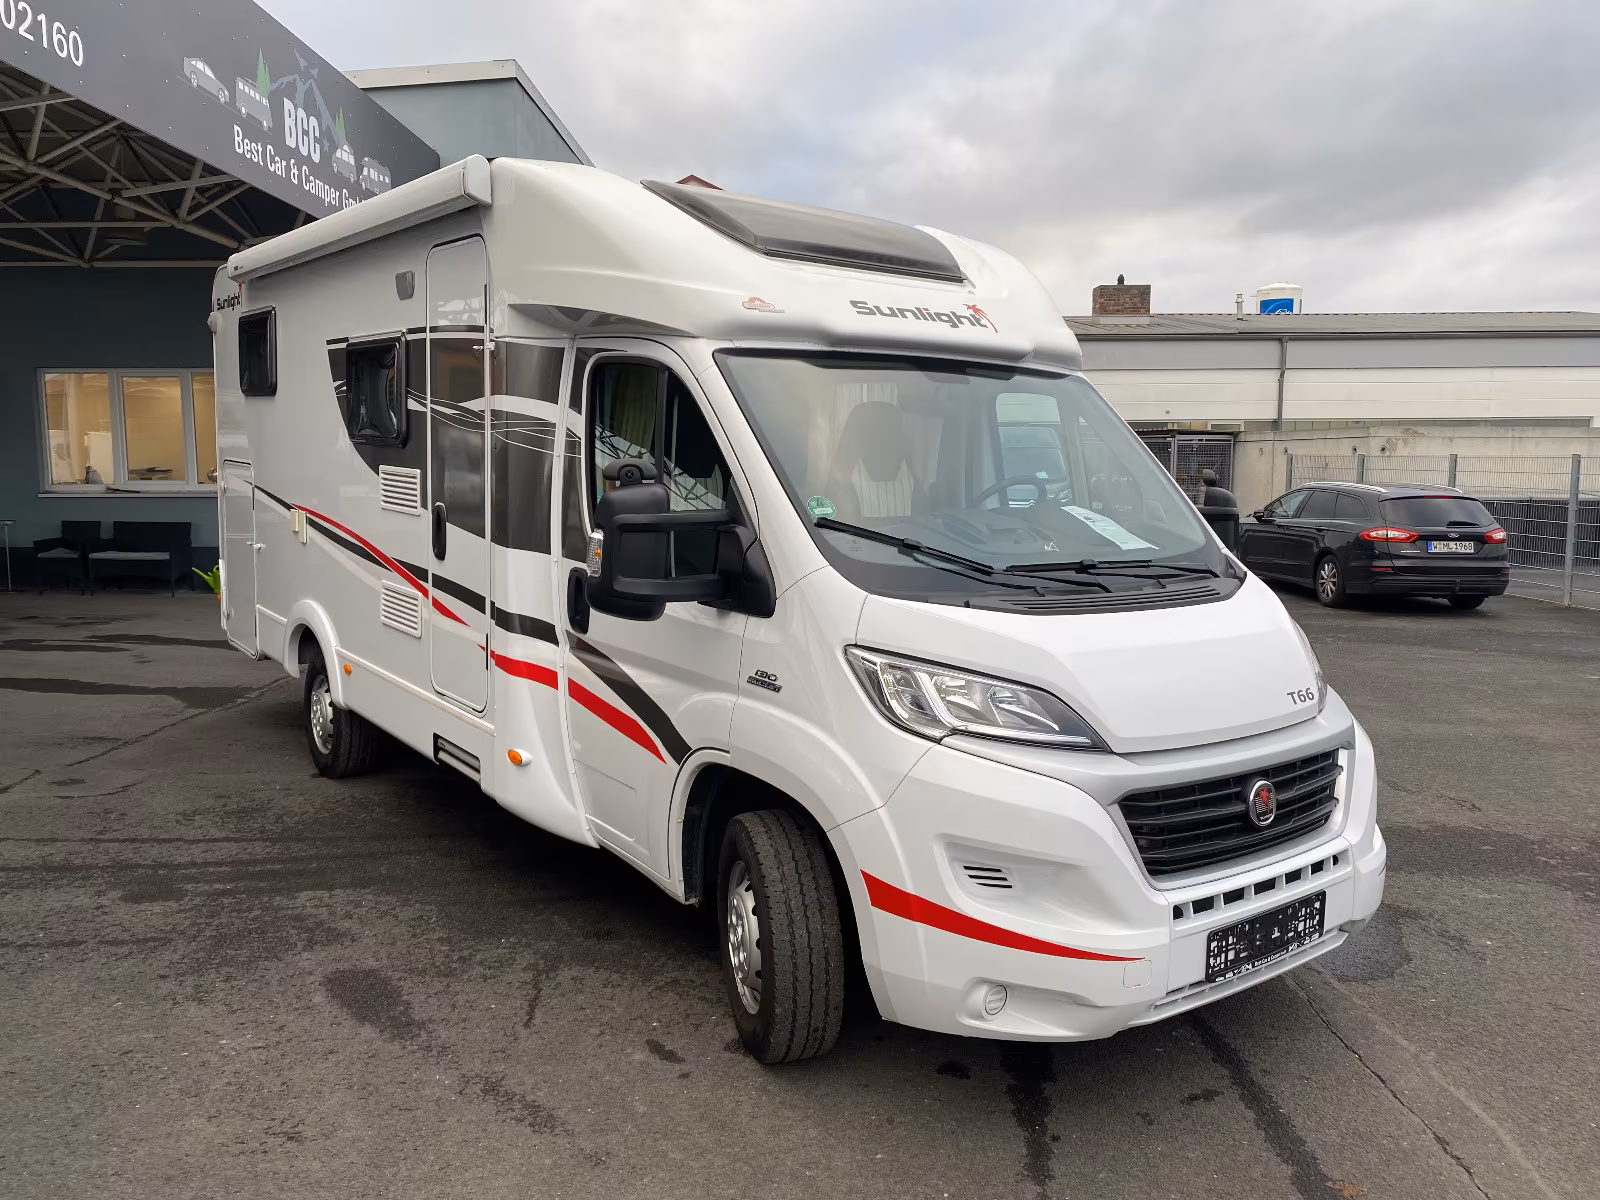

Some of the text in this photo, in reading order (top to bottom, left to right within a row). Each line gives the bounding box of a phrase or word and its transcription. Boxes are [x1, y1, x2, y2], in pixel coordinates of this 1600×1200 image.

[283, 96, 320, 163] BCC
[233, 123, 263, 166] Best
[266, 144, 287, 178] Car
[290, 158, 299, 184] &
[301, 165, 340, 207] Camper
[849, 299, 989, 329] Sunlight
[1454, 542, 1473, 551] 1968
[1286, 687, 1315, 705] T66
